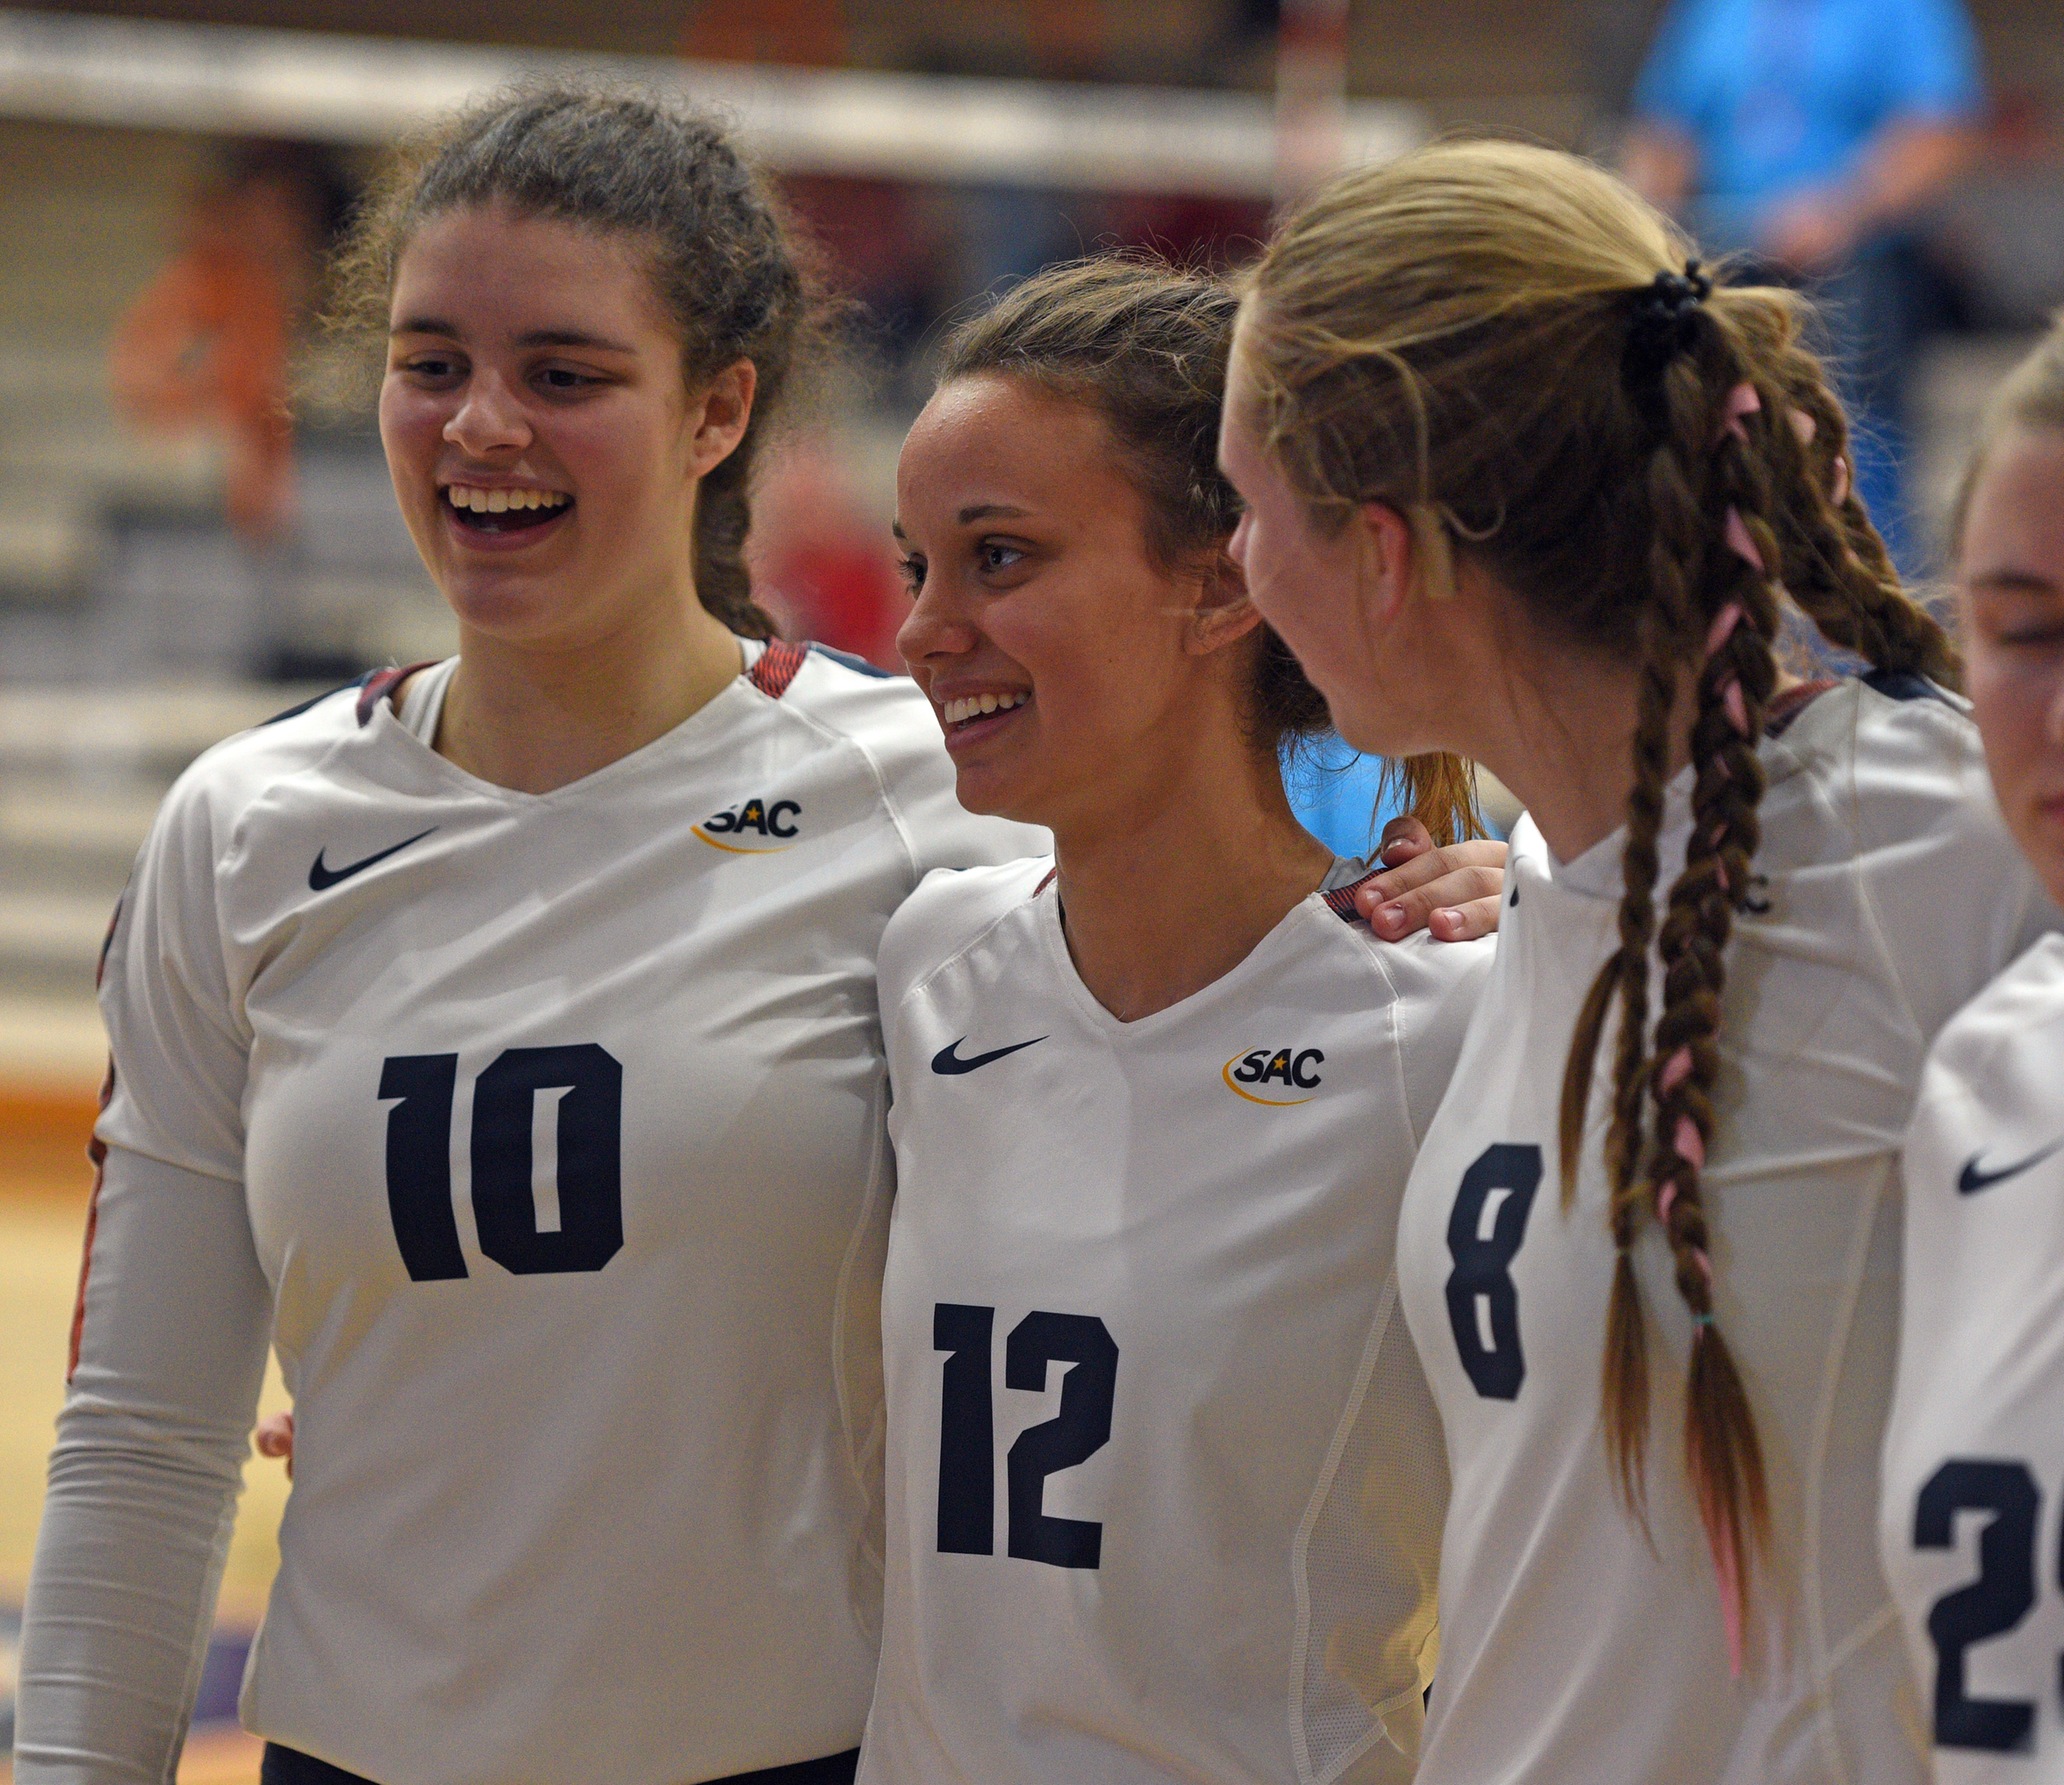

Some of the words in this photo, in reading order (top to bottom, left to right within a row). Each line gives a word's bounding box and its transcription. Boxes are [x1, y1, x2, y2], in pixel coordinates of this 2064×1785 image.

[703, 798, 802, 838] SAC
[377, 1042, 624, 1282] 10
[1233, 1048, 1325, 1089] SAC
[1445, 1142, 1545, 1402] 8
[933, 1302, 1119, 1570] 12
[1912, 1459, 2064, 1754] 2
